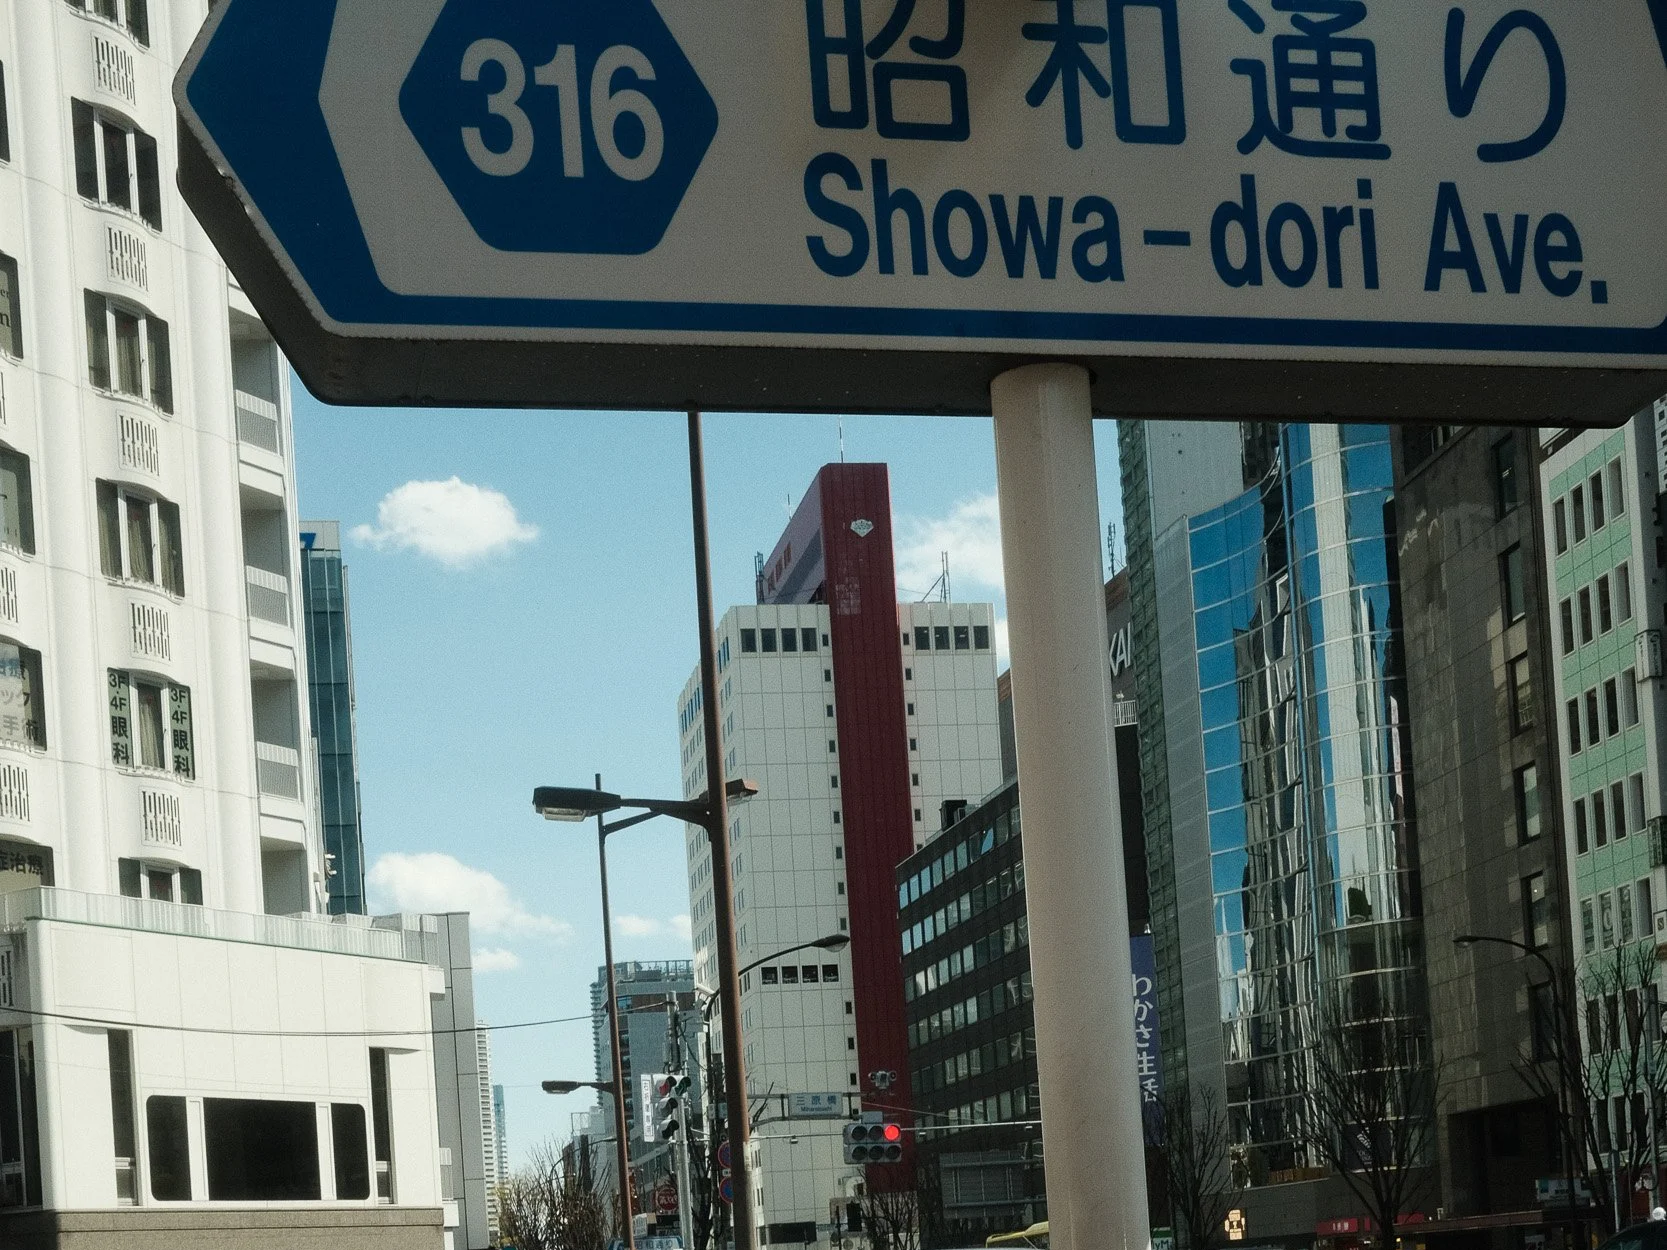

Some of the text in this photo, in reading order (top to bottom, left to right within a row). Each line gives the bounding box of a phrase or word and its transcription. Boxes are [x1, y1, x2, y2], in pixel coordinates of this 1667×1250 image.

[459, 37, 665, 182] 316
[808, 0, 1568, 164] 昭和通り
[1423, 181, 1610, 305] Ave.
